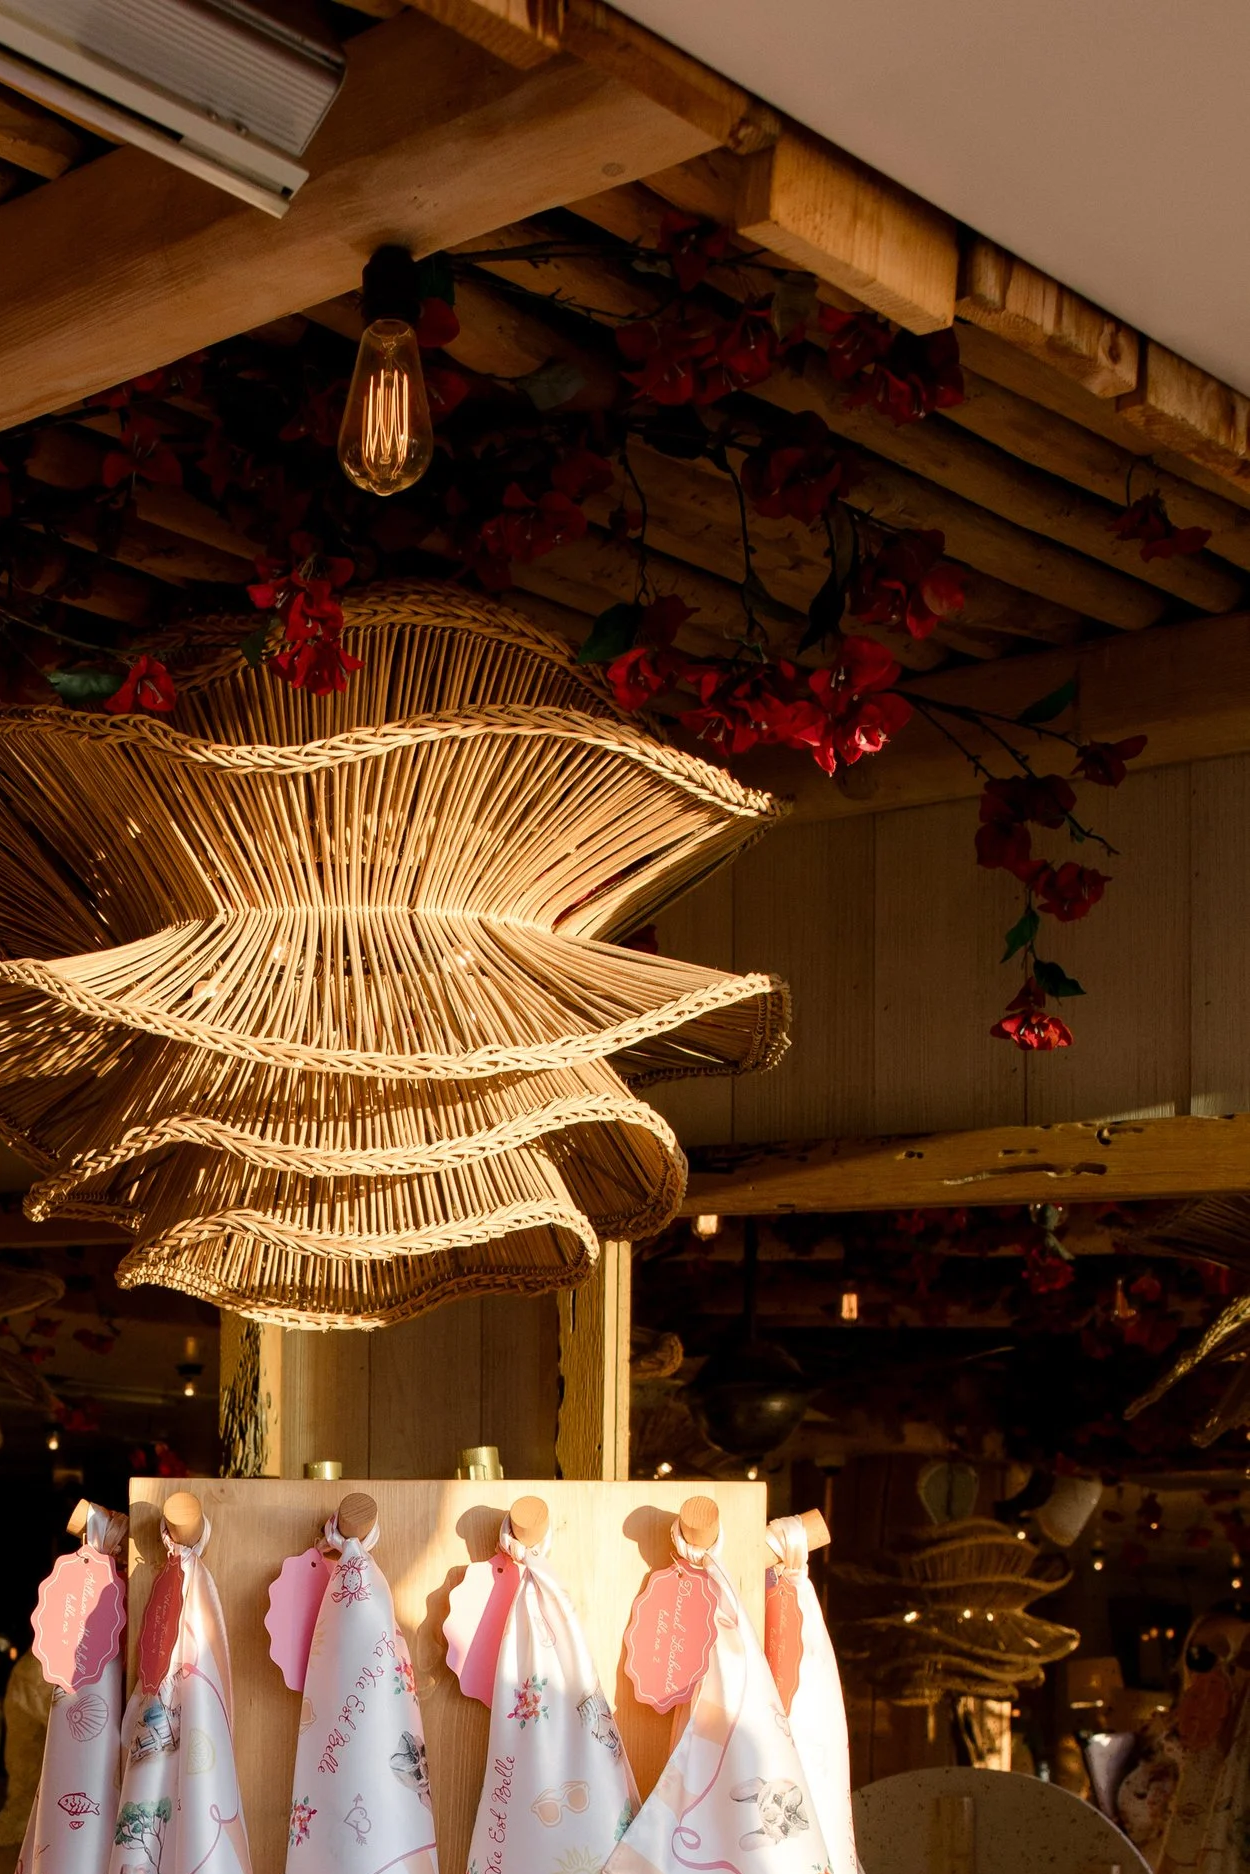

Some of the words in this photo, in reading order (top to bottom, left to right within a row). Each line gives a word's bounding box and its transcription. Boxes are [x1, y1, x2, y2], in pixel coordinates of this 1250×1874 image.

[65, 1593, 77, 1618] table
[80, 1570, 96, 1615] Allison
[673, 1580, 693, 1632] Daniel
[656, 1609, 670, 1635] table
[373, 1631, 396, 1657] La
[356, 1666, 384, 1689] Vie
[339, 1694, 365, 1730] Est
[318, 1728, 351, 1774] Belle
[491, 1755, 516, 1804] Belle
[488, 1808, 507, 1843] Est
